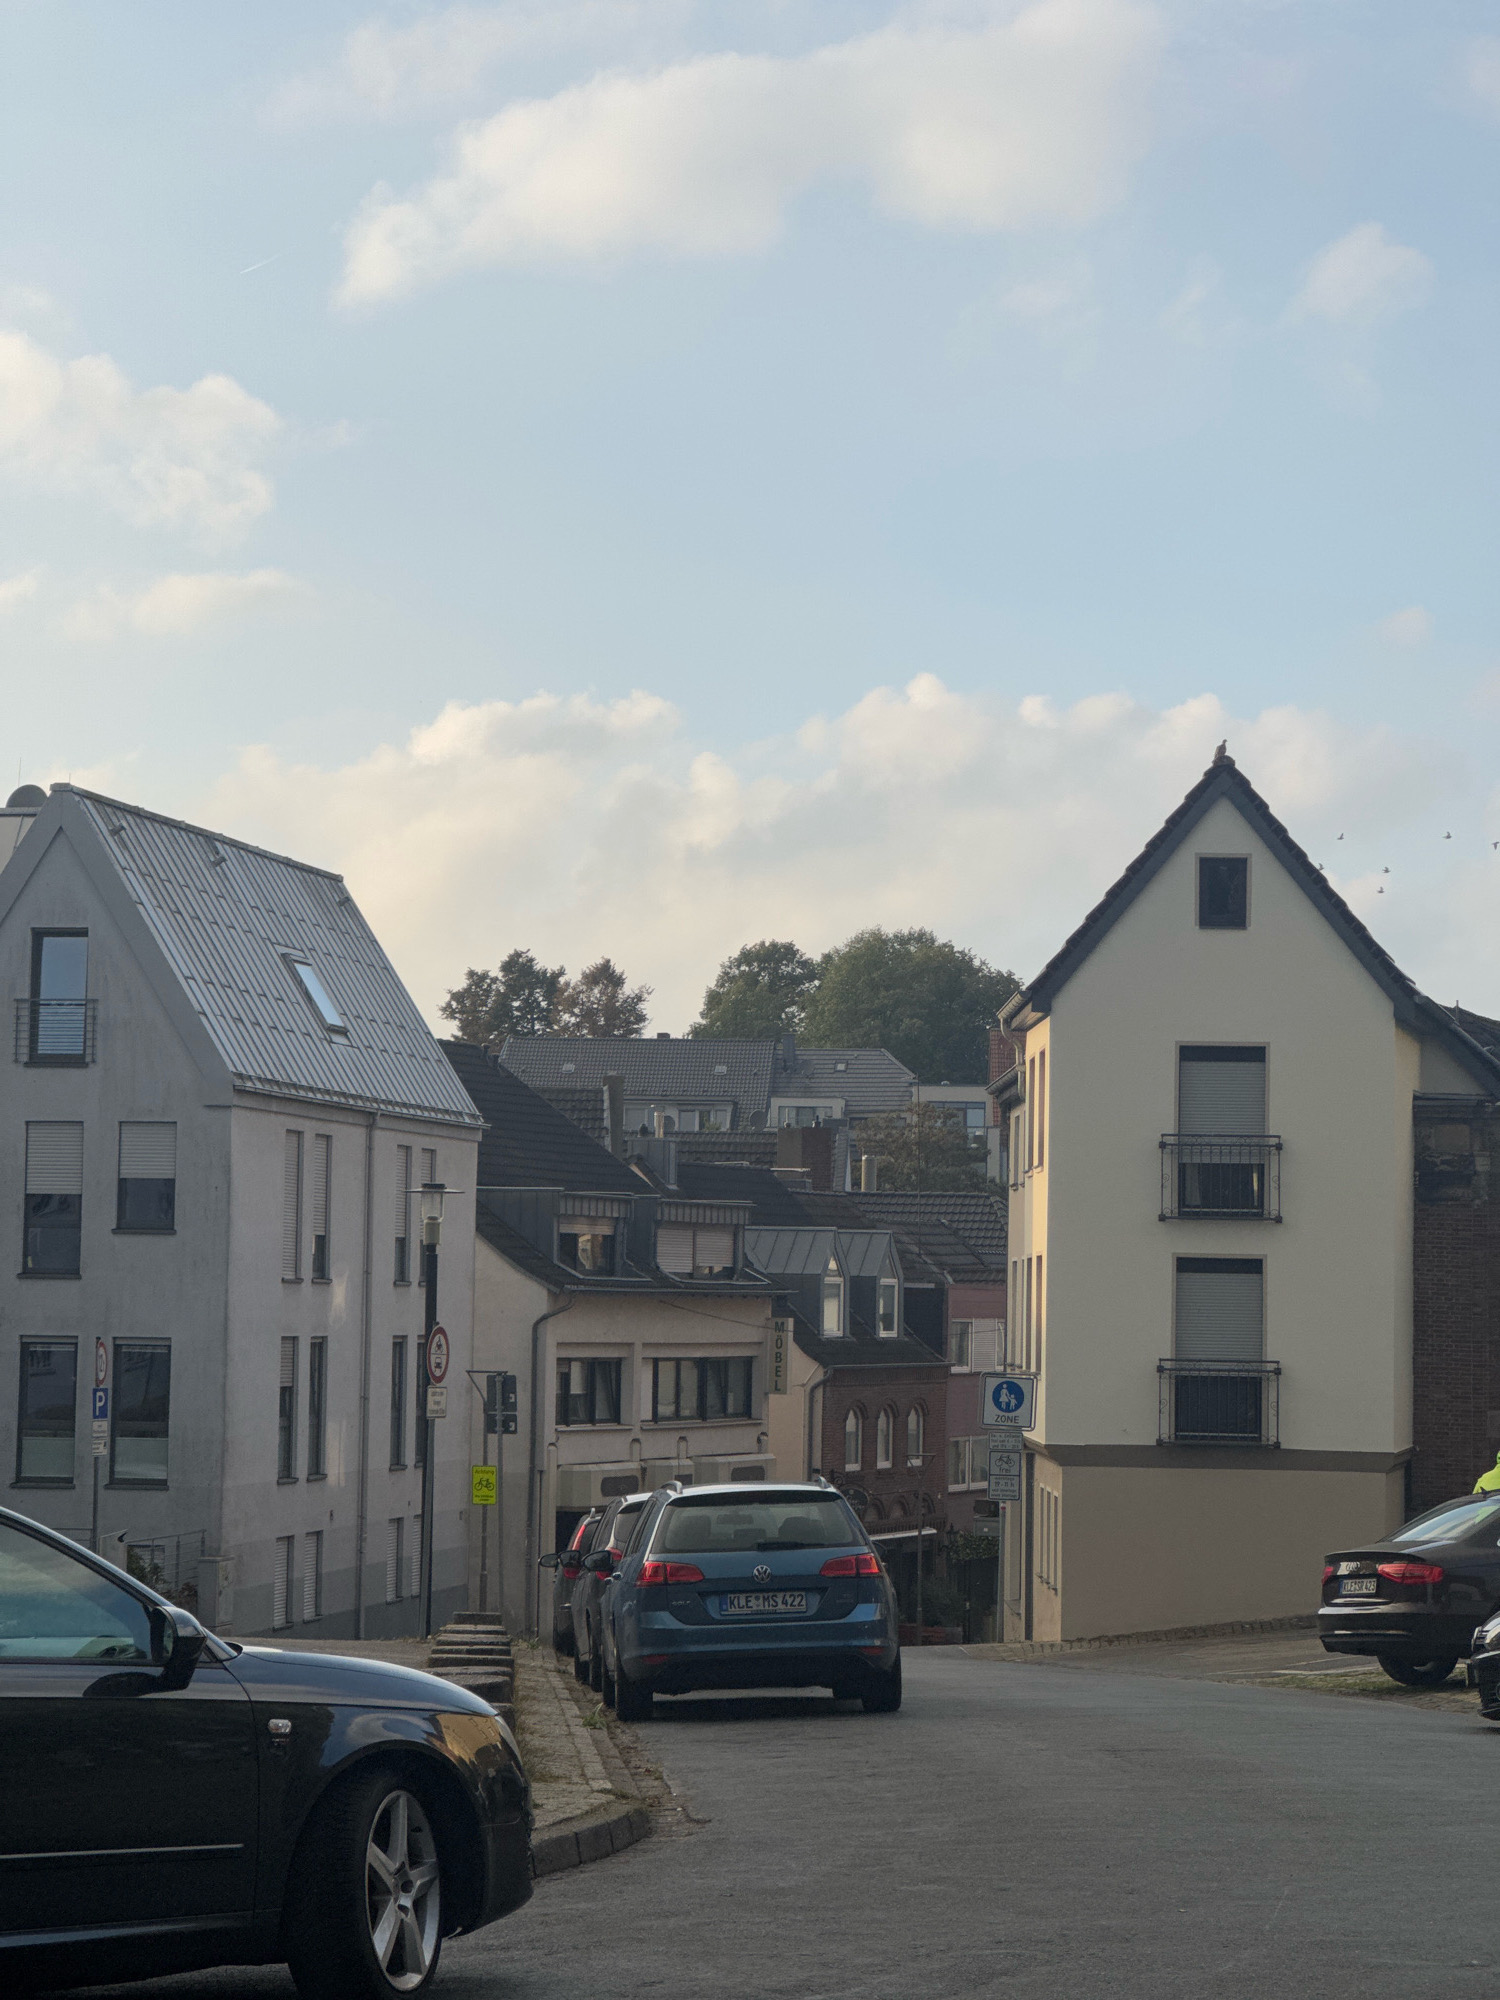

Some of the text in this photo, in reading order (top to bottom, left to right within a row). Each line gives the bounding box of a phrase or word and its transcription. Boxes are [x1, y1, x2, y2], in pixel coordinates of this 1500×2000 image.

[774, 1321, 785, 1392] MÖBEL
[95, 1391, 105, 1416] P
[994, 1414, 1020, 1424] ZONE
[729, 1592, 805, 1610] KLE MS 422
